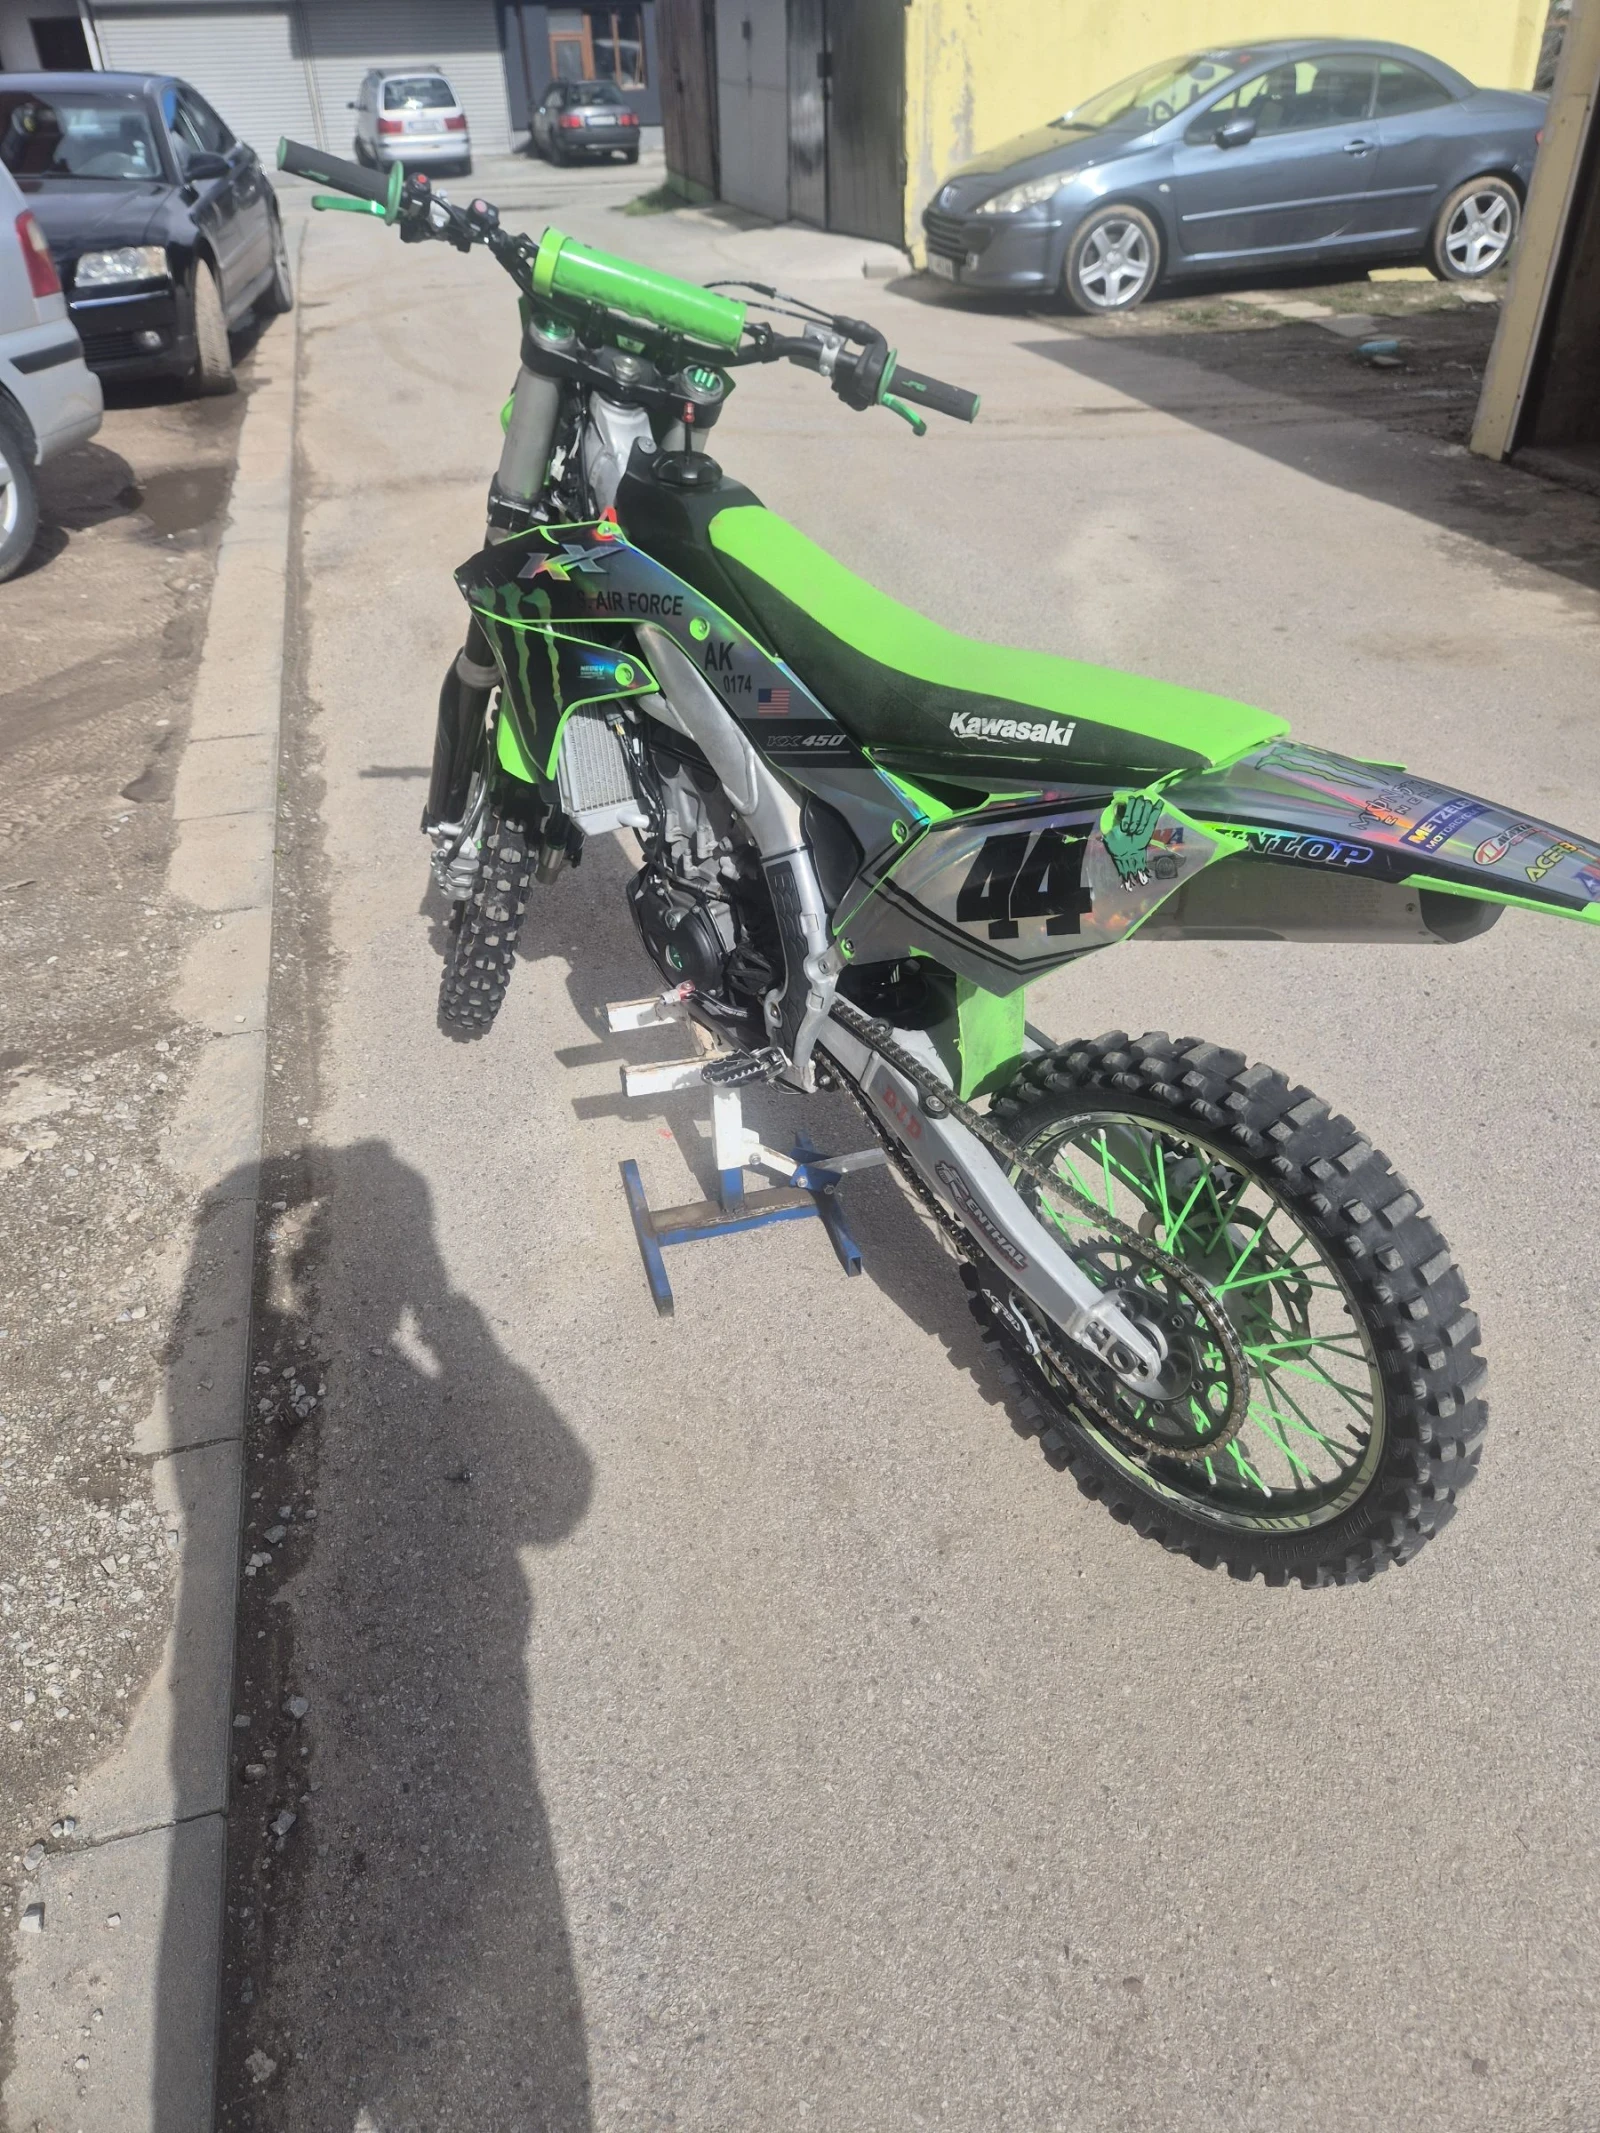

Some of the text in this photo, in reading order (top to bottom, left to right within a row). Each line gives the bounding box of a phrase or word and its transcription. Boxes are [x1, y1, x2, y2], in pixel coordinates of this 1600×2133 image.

[517, 543, 627, 581] KX
[595, 590, 625, 612] AIR
[628, 592, 685, 616] FORCE
[704, 641, 735, 672] AK
[723, 674, 752, 694] 0174
[949, 712, 1076, 746] Kawasaki
[956, 822, 1095, 939] 44
